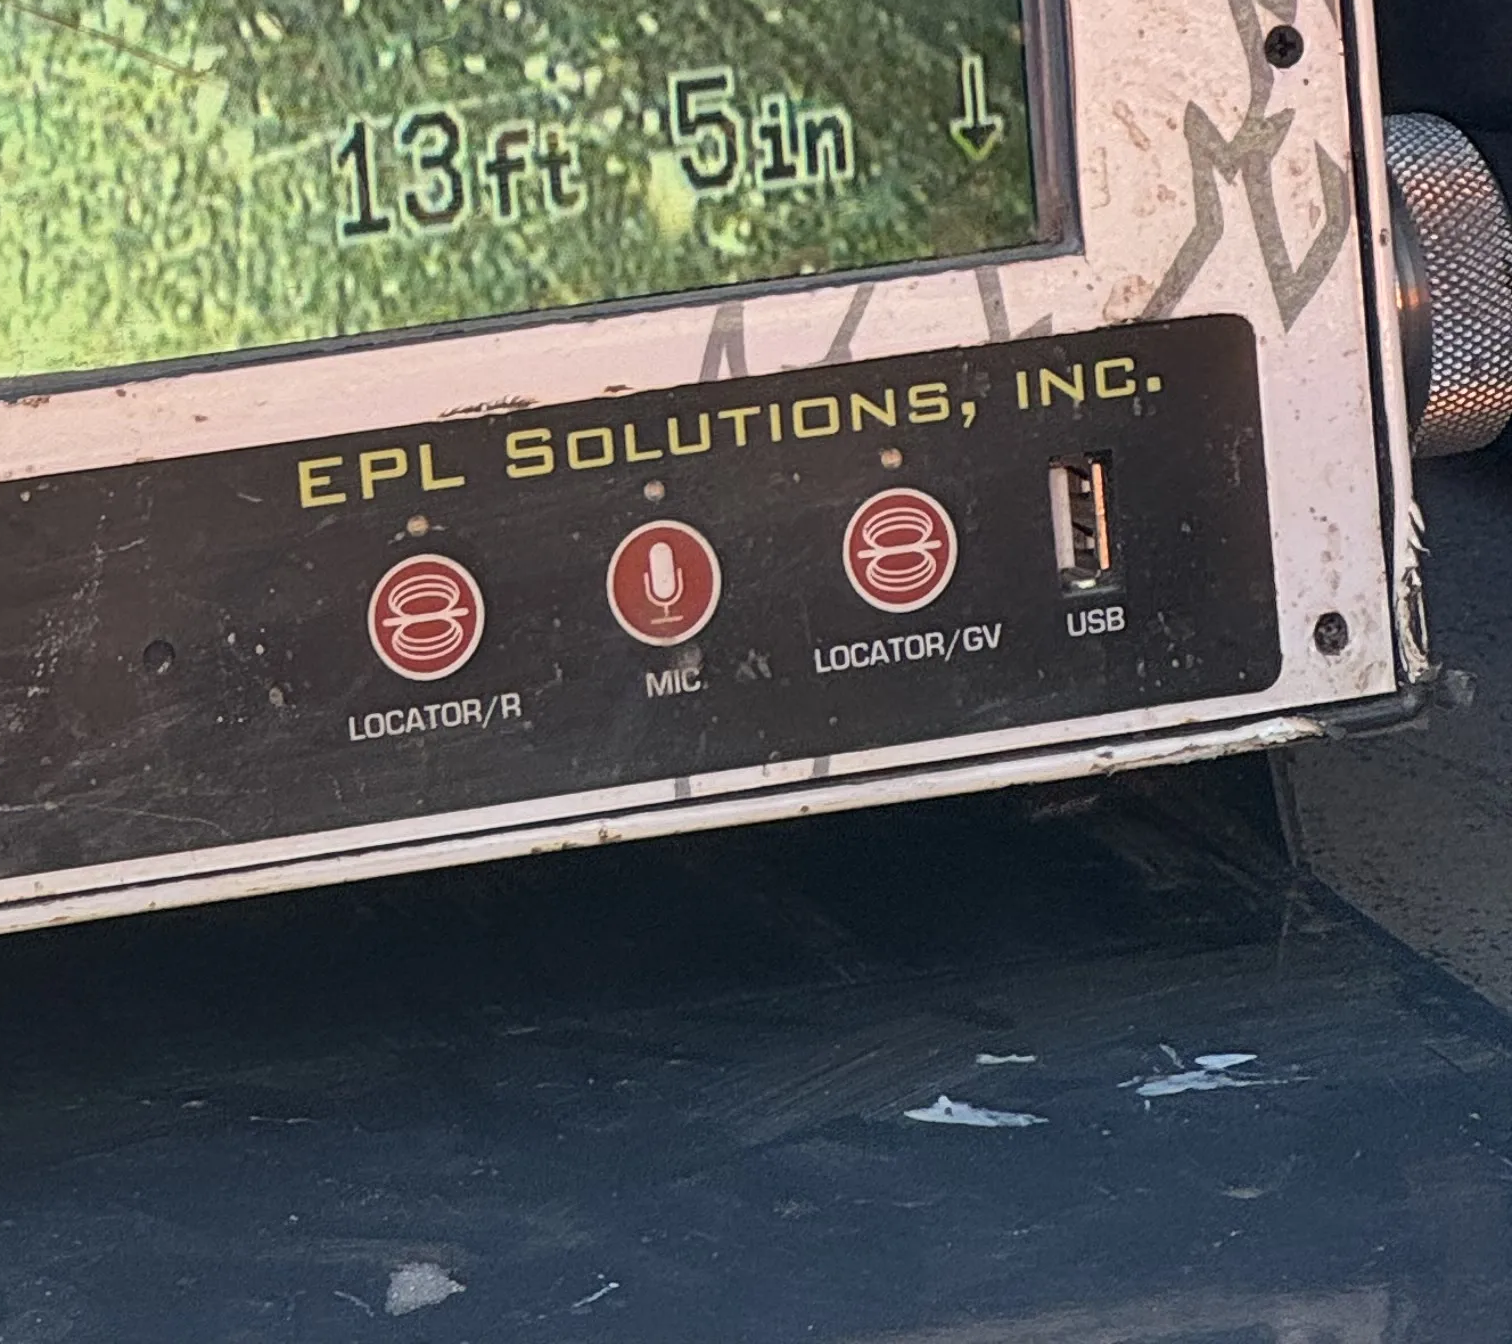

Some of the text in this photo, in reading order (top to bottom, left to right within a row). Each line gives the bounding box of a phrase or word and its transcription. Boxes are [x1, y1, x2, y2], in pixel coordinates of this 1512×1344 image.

[334, 66, 855, 241] 13ft 5in
[298, 355, 1165, 508] EPL SOLUTIONS, INC.
[1066, 607, 1126, 637] USB
[813, 622, 1004, 676] LOCATOR/GV
[645, 668, 702, 700] MIC
[347, 691, 524, 744] LOCATOR/R
